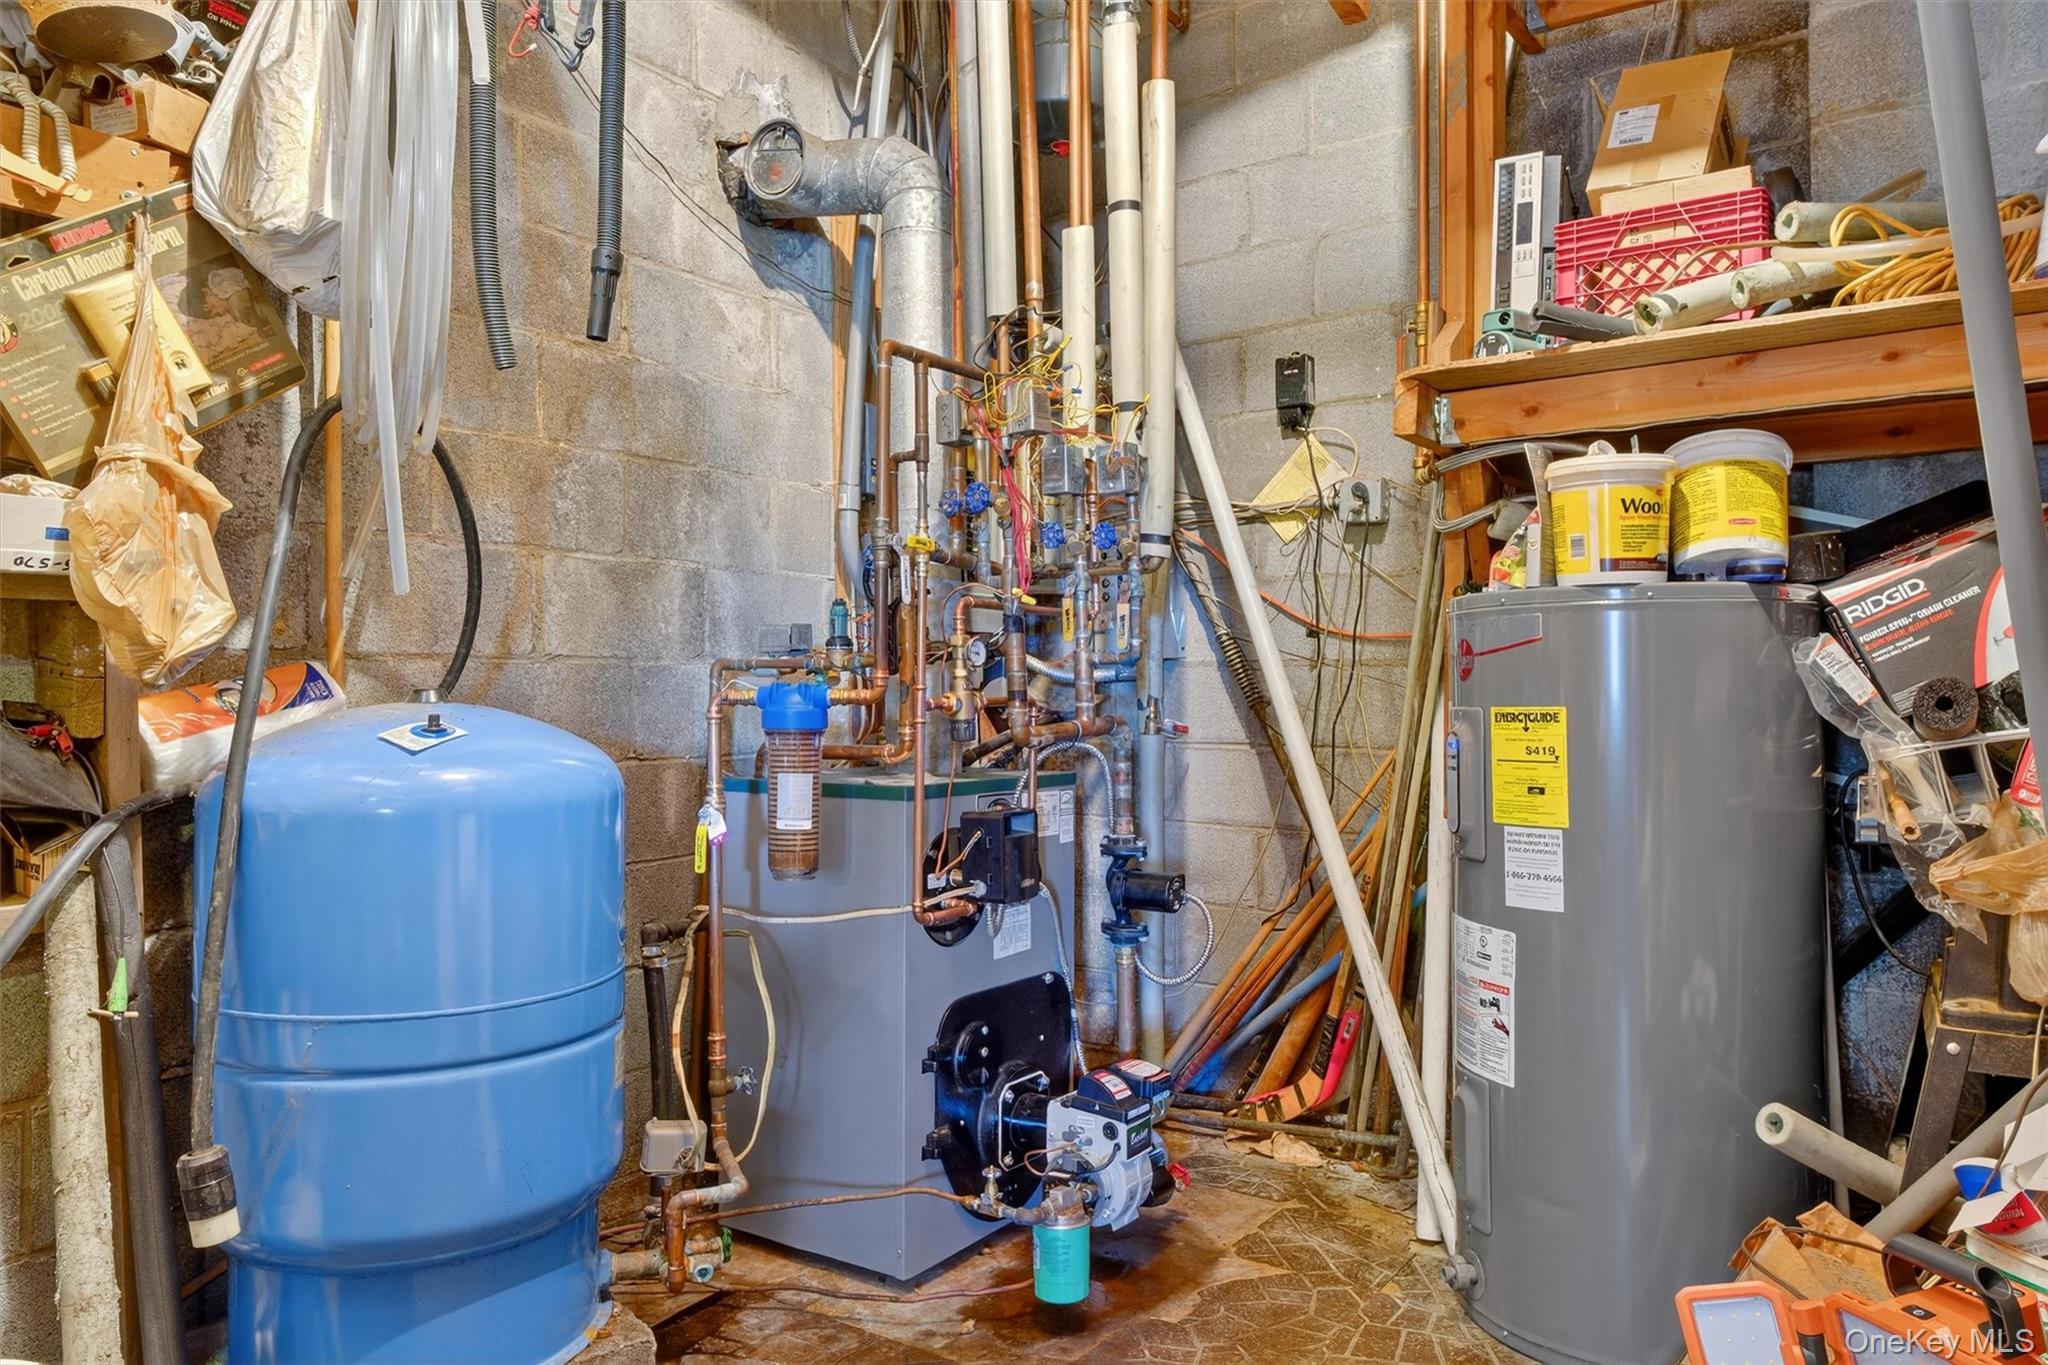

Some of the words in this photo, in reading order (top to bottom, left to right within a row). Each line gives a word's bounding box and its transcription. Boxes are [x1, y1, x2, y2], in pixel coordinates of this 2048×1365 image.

[11, 264, 75, 301] Carbon
[150, 225, 185, 256] arm
[1843, 579, 1927, 624] RIDGID
